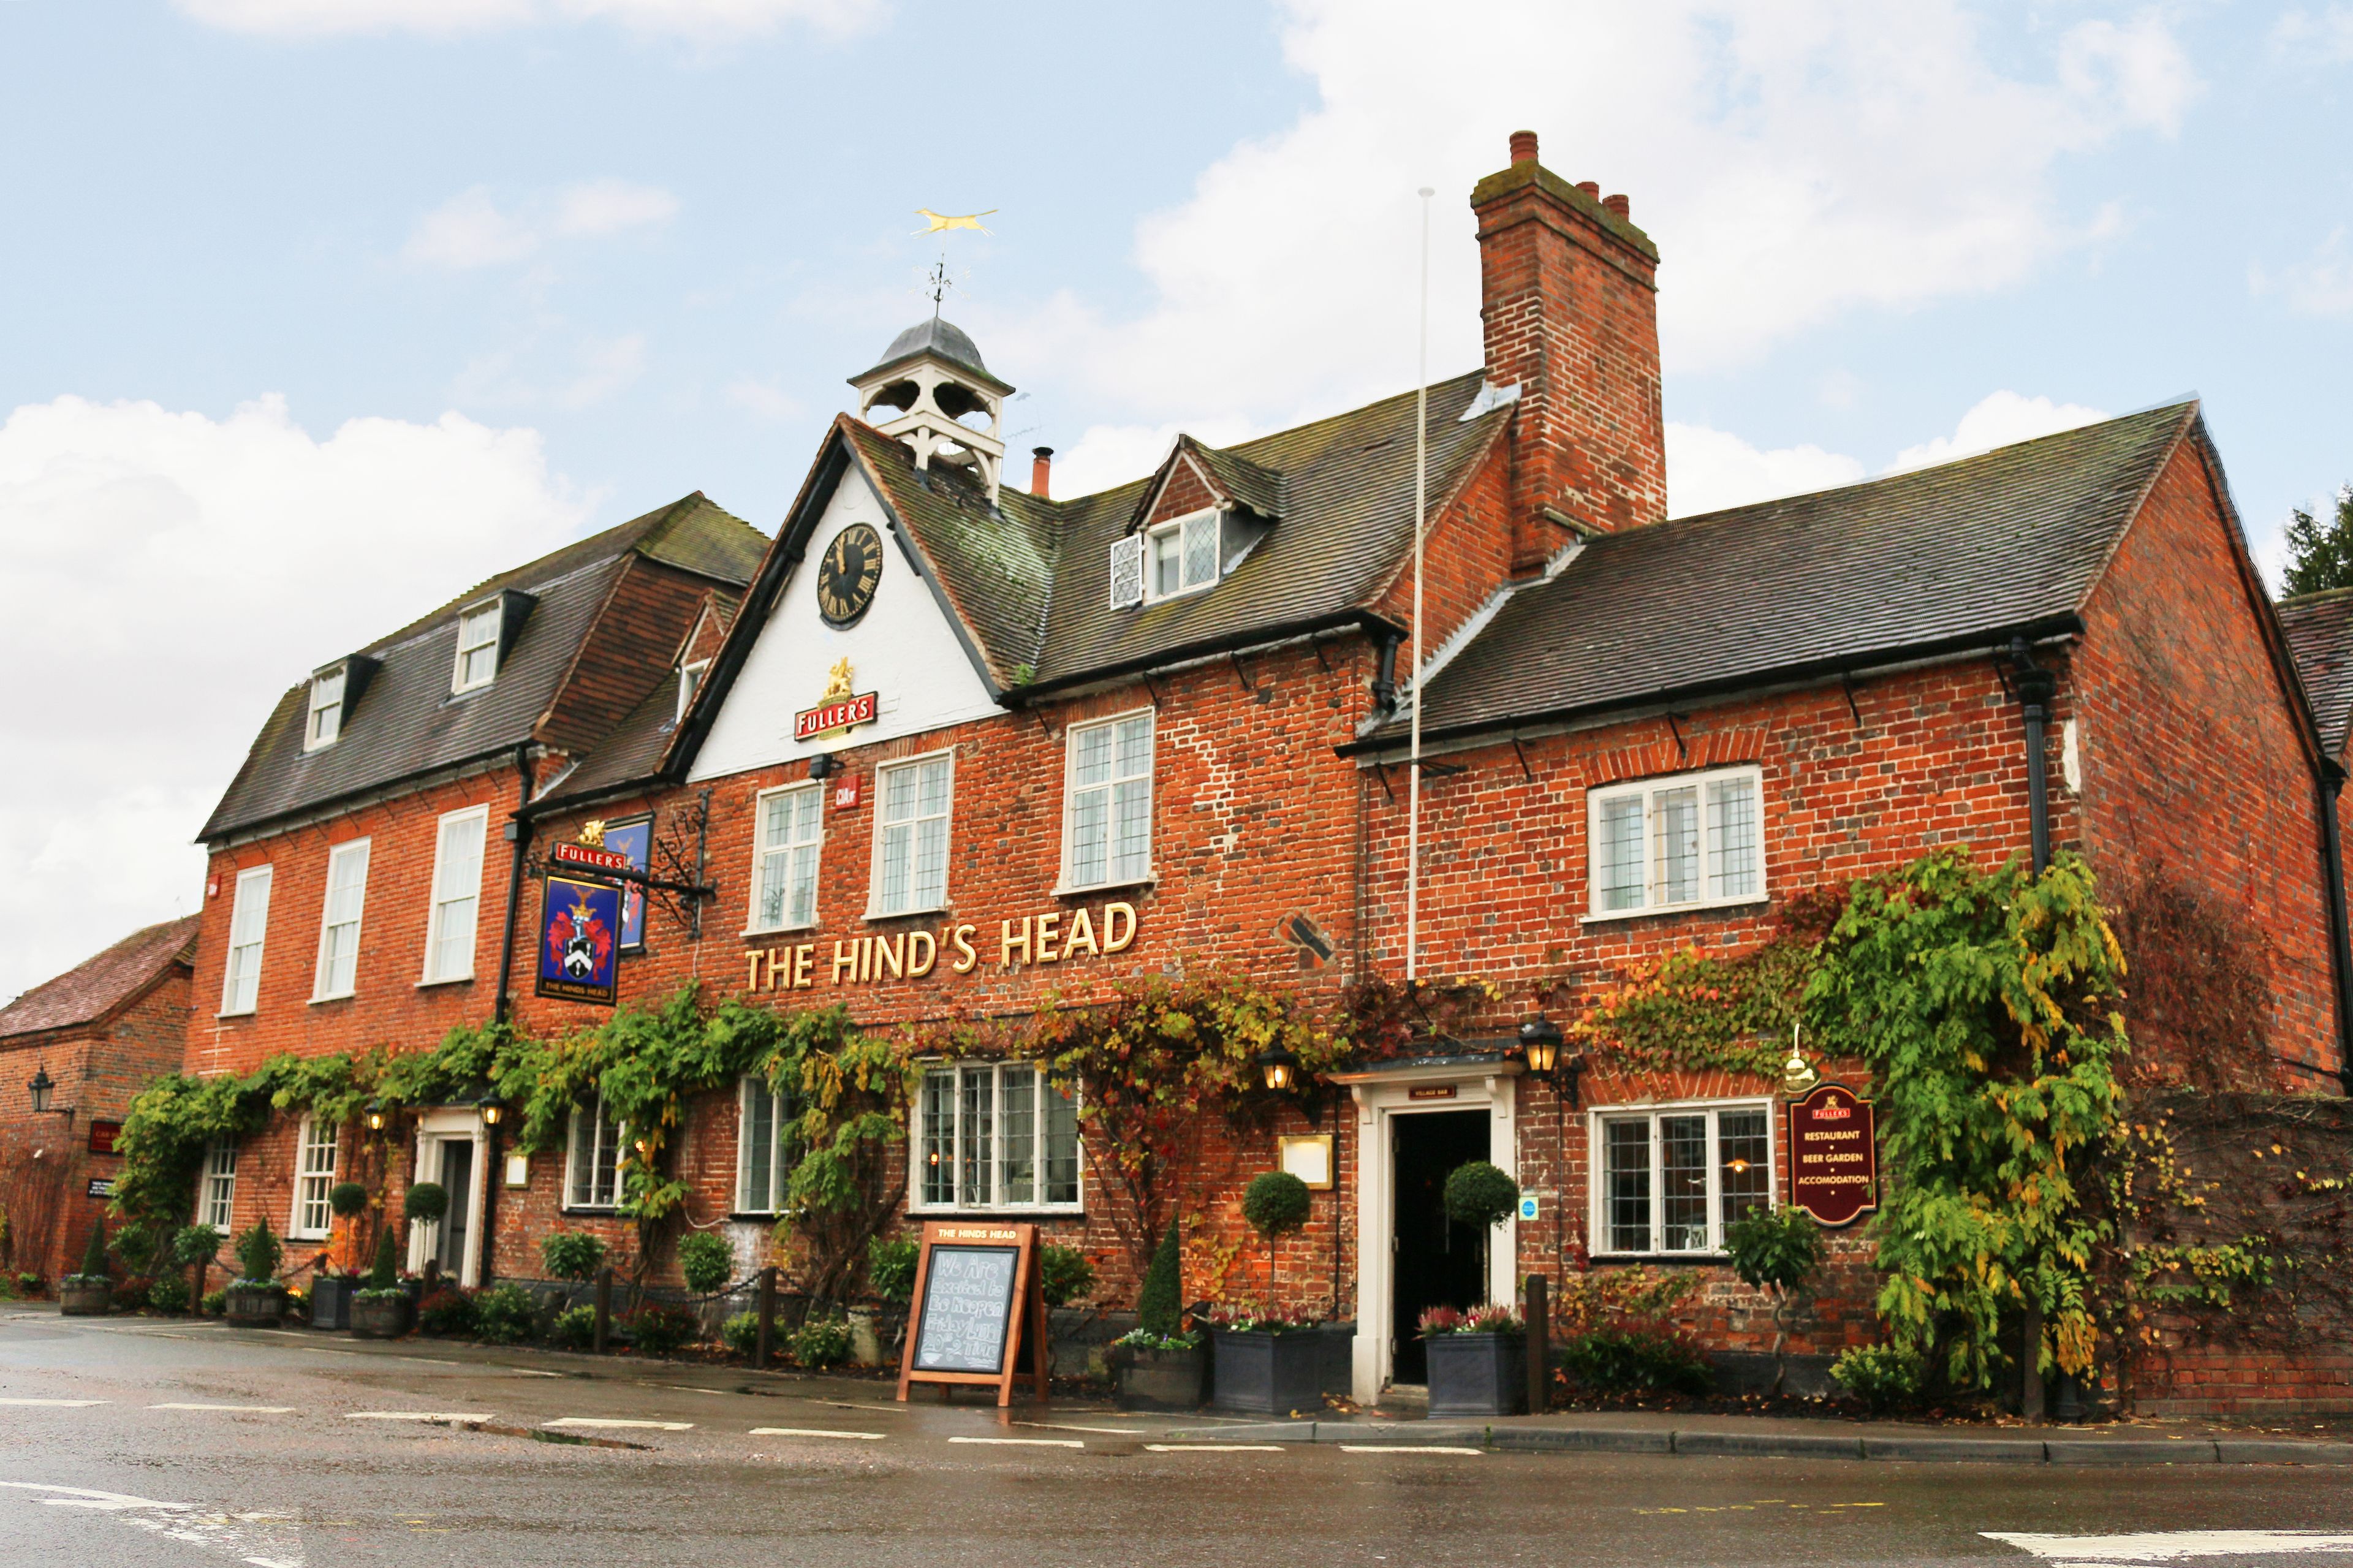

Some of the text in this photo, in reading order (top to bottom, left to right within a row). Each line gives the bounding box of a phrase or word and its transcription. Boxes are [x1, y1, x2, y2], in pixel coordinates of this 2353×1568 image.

[798, 700, 868, 734] FULLER'S
[745, 901, 1137, 992] THE HIND'S HEAD
[546, 982, 559, 991] THE
[587, 988, 608, 998] HEAD
[1804, 1131, 1860, 1141] RESTAURANT
[1803, 1153, 1863, 1164] BEER GARDEN
[1798, 1175, 1869, 1185] ACCOMODATION
[938, 1229, 1017, 1239] THE HINDS HEAD
[938, 1253, 999, 1280] We Are
[988, 1279, 1004, 1297] to
[928, 1294, 950, 1312] Be
[924, 1312, 966, 1338] Friday
